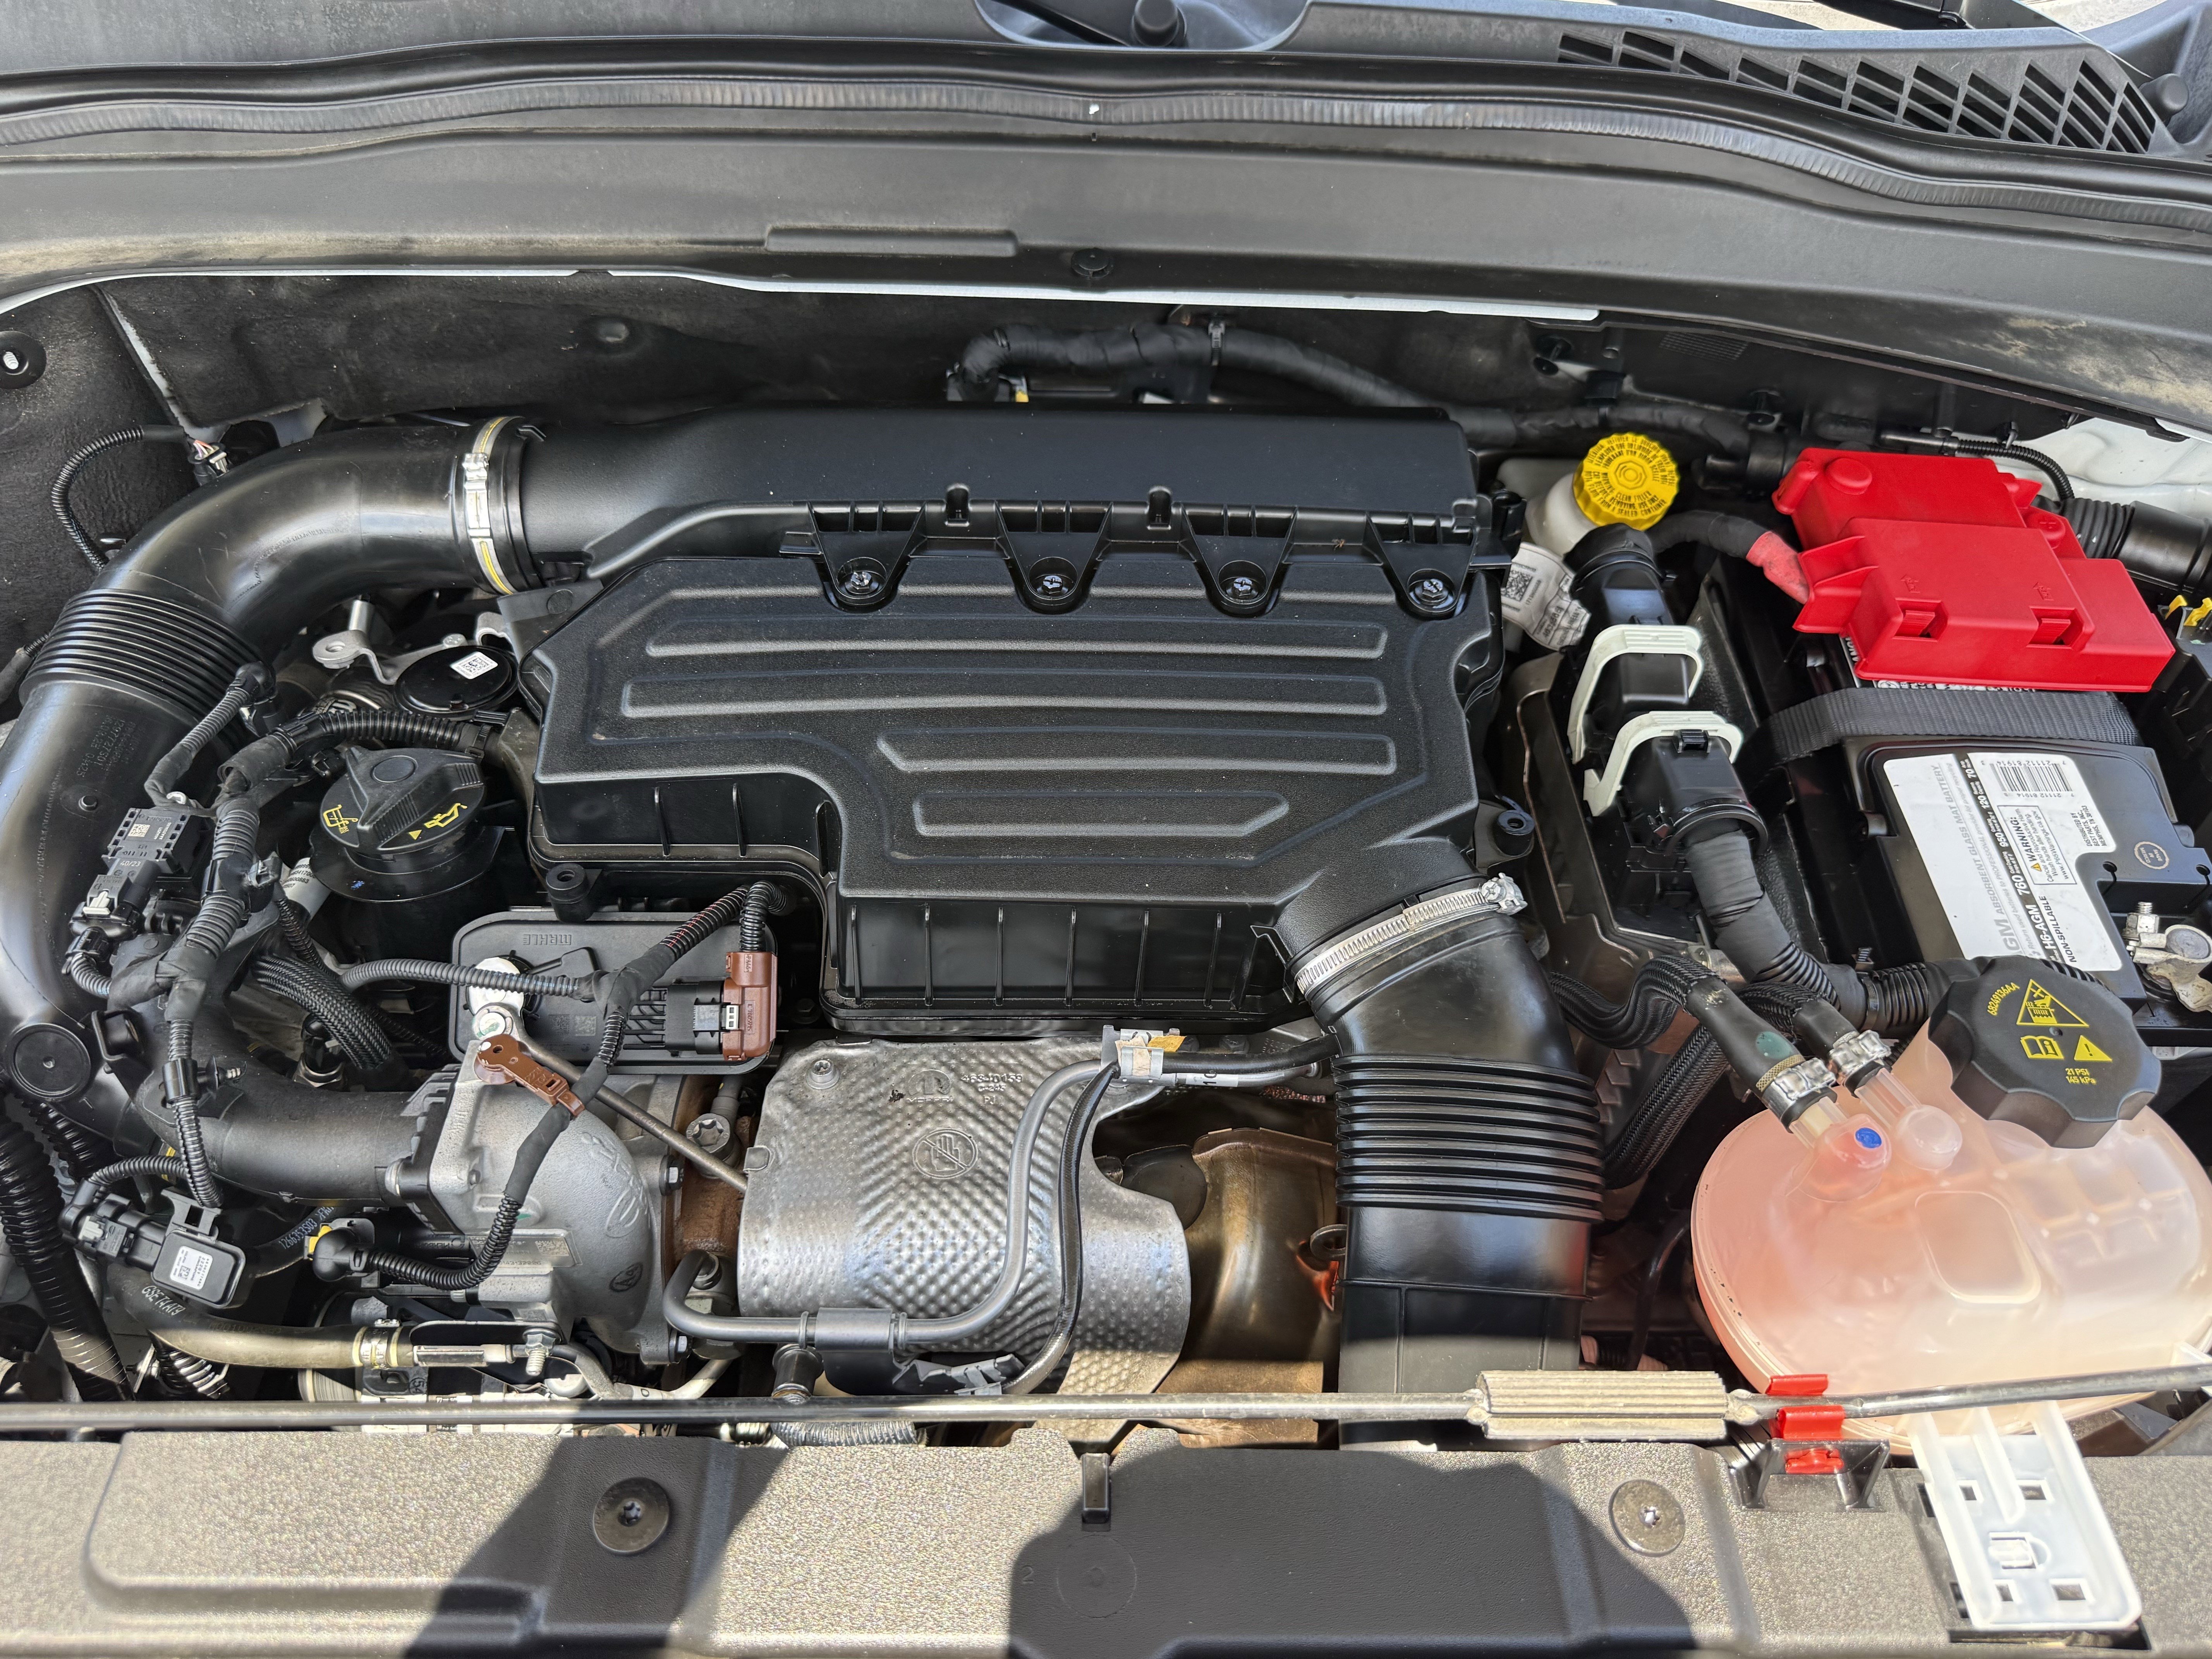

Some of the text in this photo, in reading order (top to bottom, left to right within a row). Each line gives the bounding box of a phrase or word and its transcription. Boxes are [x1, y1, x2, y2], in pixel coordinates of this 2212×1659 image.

[1944, 763, 1961, 785] recycling
[1964, 768, 1978, 778] 70
[1930, 765, 1954, 802] BATTERY
[1955, 787, 1969, 804] proper
[1976, 795, 1992, 809] 120
[1948, 805, 1964, 823] MAT
[1967, 813, 1983, 835] provider
[1958, 827, 1978, 855] GLASS
[1993, 832, 2011, 847] 950
[2008, 817, 2038, 861] WARNING:
[2021, 823, 2042, 852] Reproductive
[2033, 835, 2044, 845] after
[2073, 819, 2093, 846] DISTRIBUTED
[2090, 836, 2100, 846] BEST
[2030, 810, 2071, 879] www.P65Warnings.ca.gov
[2038, 846, 2052, 861] hands
[1977, 836, 2003, 879] PROFESSIONAL
[2036, 854, 2046, 863] and
[2040, 864, 2055, 881] Cancer
[2046, 862, 2059, 876] Wash
[1972, 858, 2004, 914] ABSORBENT
[2010, 874, 2032, 895] 760
[2001, 888, 2017, 910] batteries
[2013, 914, 2026, 928] used
[2024, 904, 2057, 950] H6-AGM
[2038, 895, 2077, 962] NON-SPILLABLE
[523, 934, 572, 945] MAHLE
[2020, 929, 2035, 949] Return
[1987, 982, 2020, 1016] 68249136AA
[2066, 1076, 2097, 1085] 145 kPa
[2074, 1068, 2090, 1076] PSI
[278, 1219, 316, 1250] 1266353S03
[141, 1285, 165, 1302] GSE
